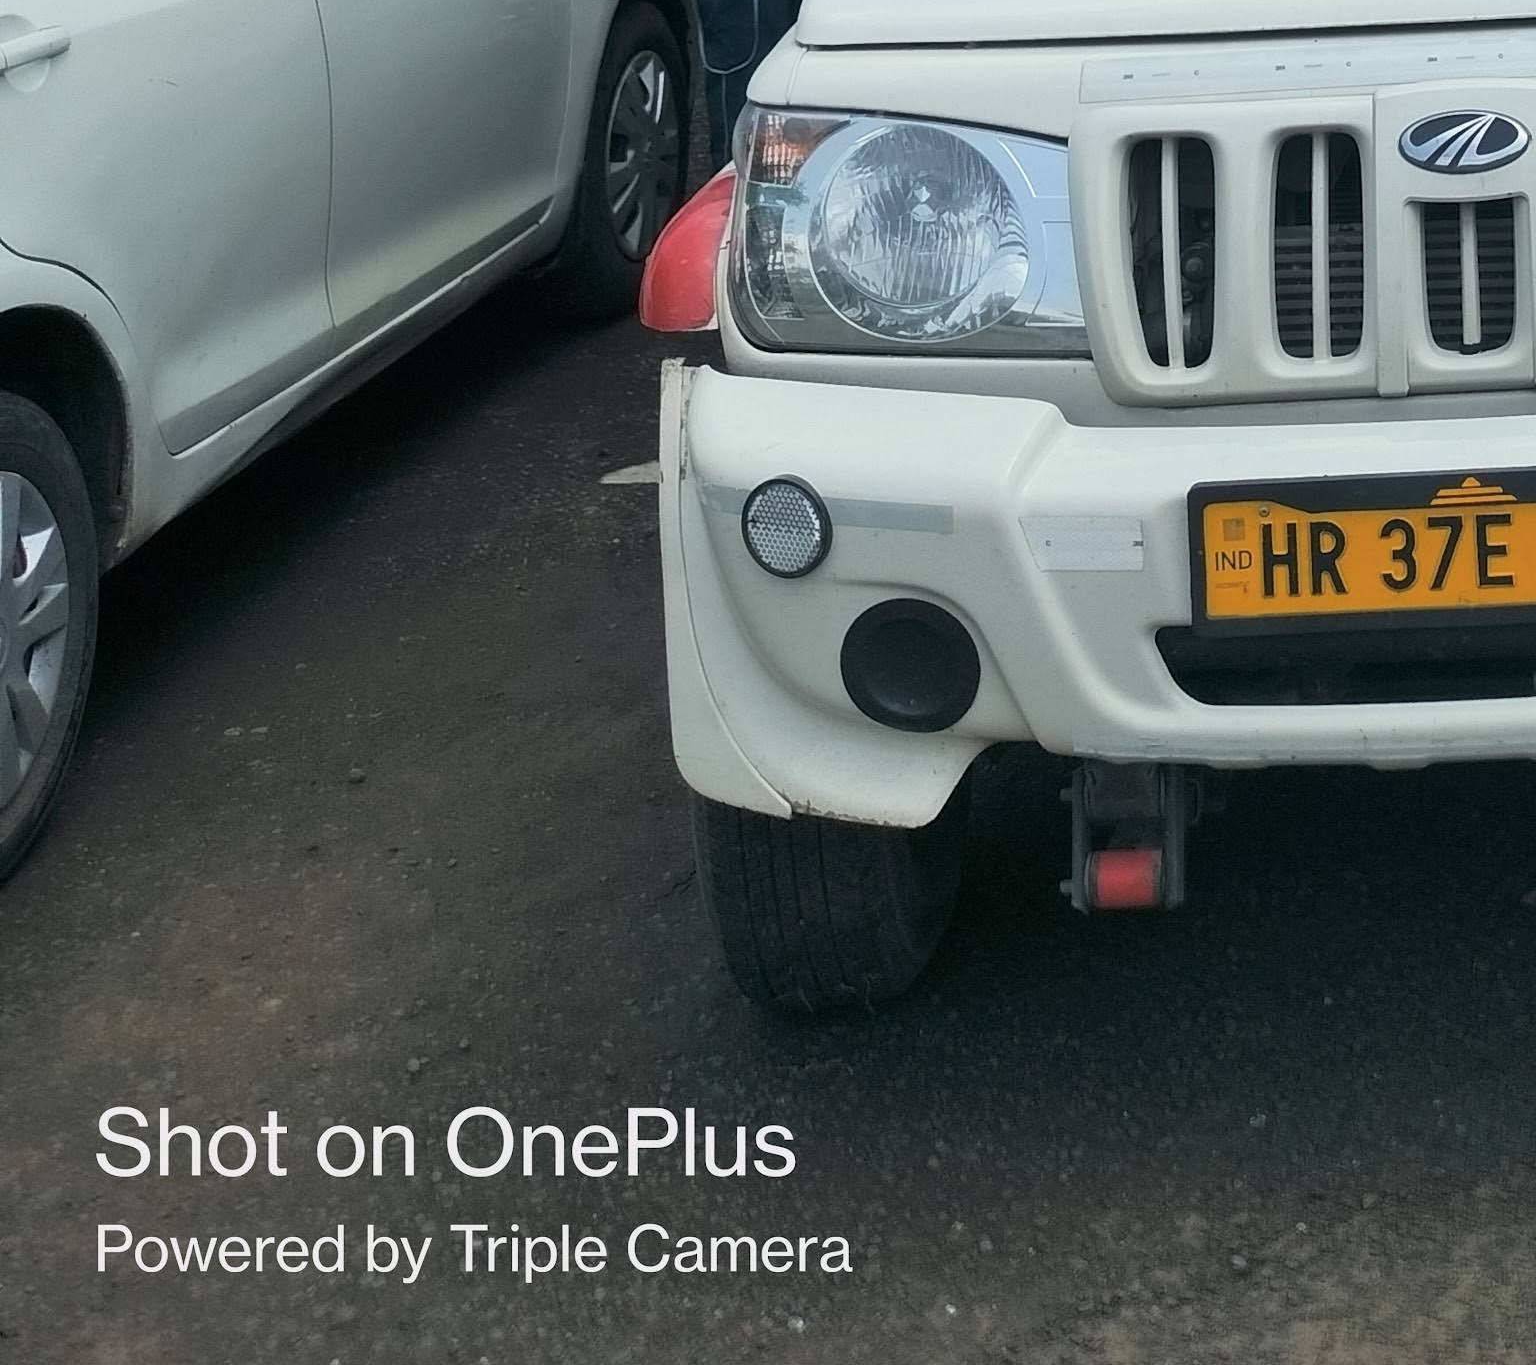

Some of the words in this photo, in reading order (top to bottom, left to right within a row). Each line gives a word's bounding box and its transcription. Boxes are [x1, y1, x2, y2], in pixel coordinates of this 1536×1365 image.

[1214, 550, 1253, 572] IND
[1261, 519, 1349, 597] HR
[1379, 513, 1515, 592] 37E
